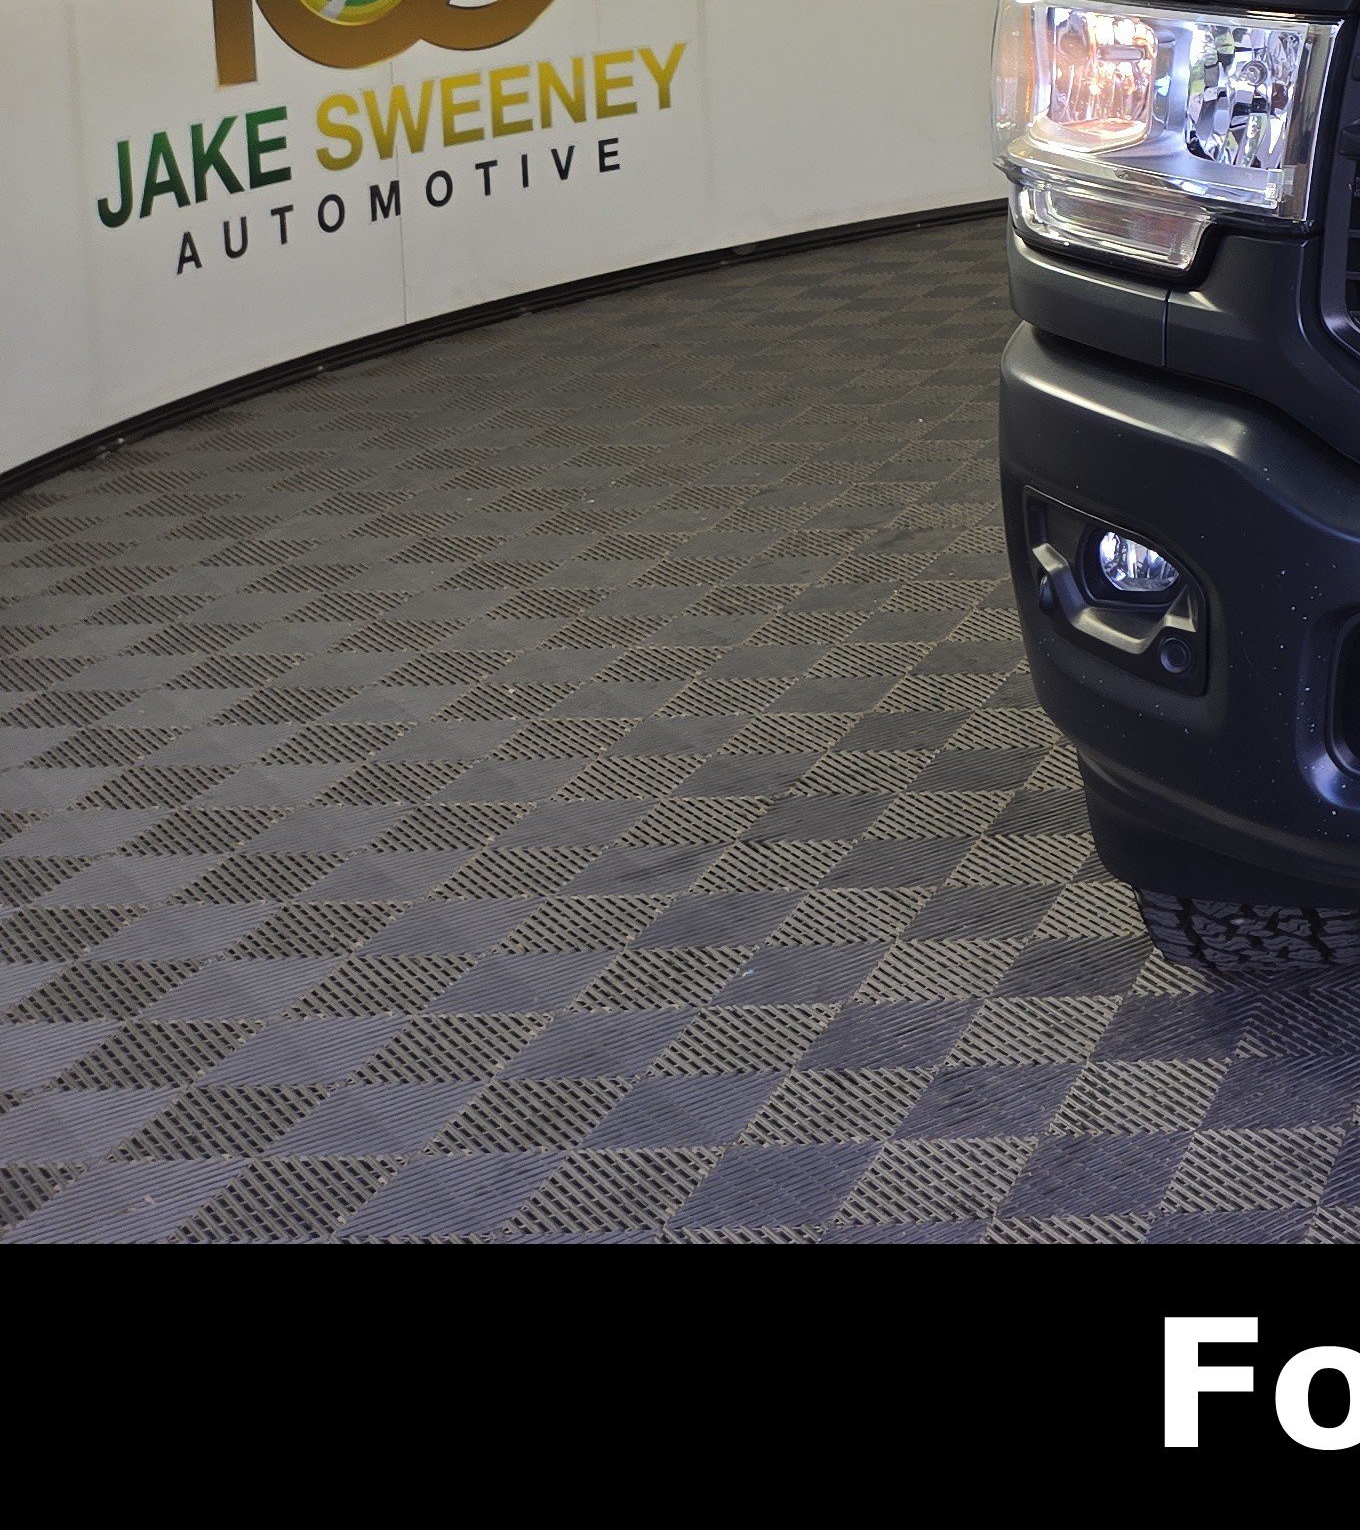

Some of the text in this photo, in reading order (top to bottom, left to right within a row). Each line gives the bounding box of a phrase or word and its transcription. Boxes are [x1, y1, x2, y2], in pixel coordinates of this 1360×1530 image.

[98, 43, 687, 228] JAKE SWEENEY
[177, 138, 620, 275] AUTOMOTIVE
